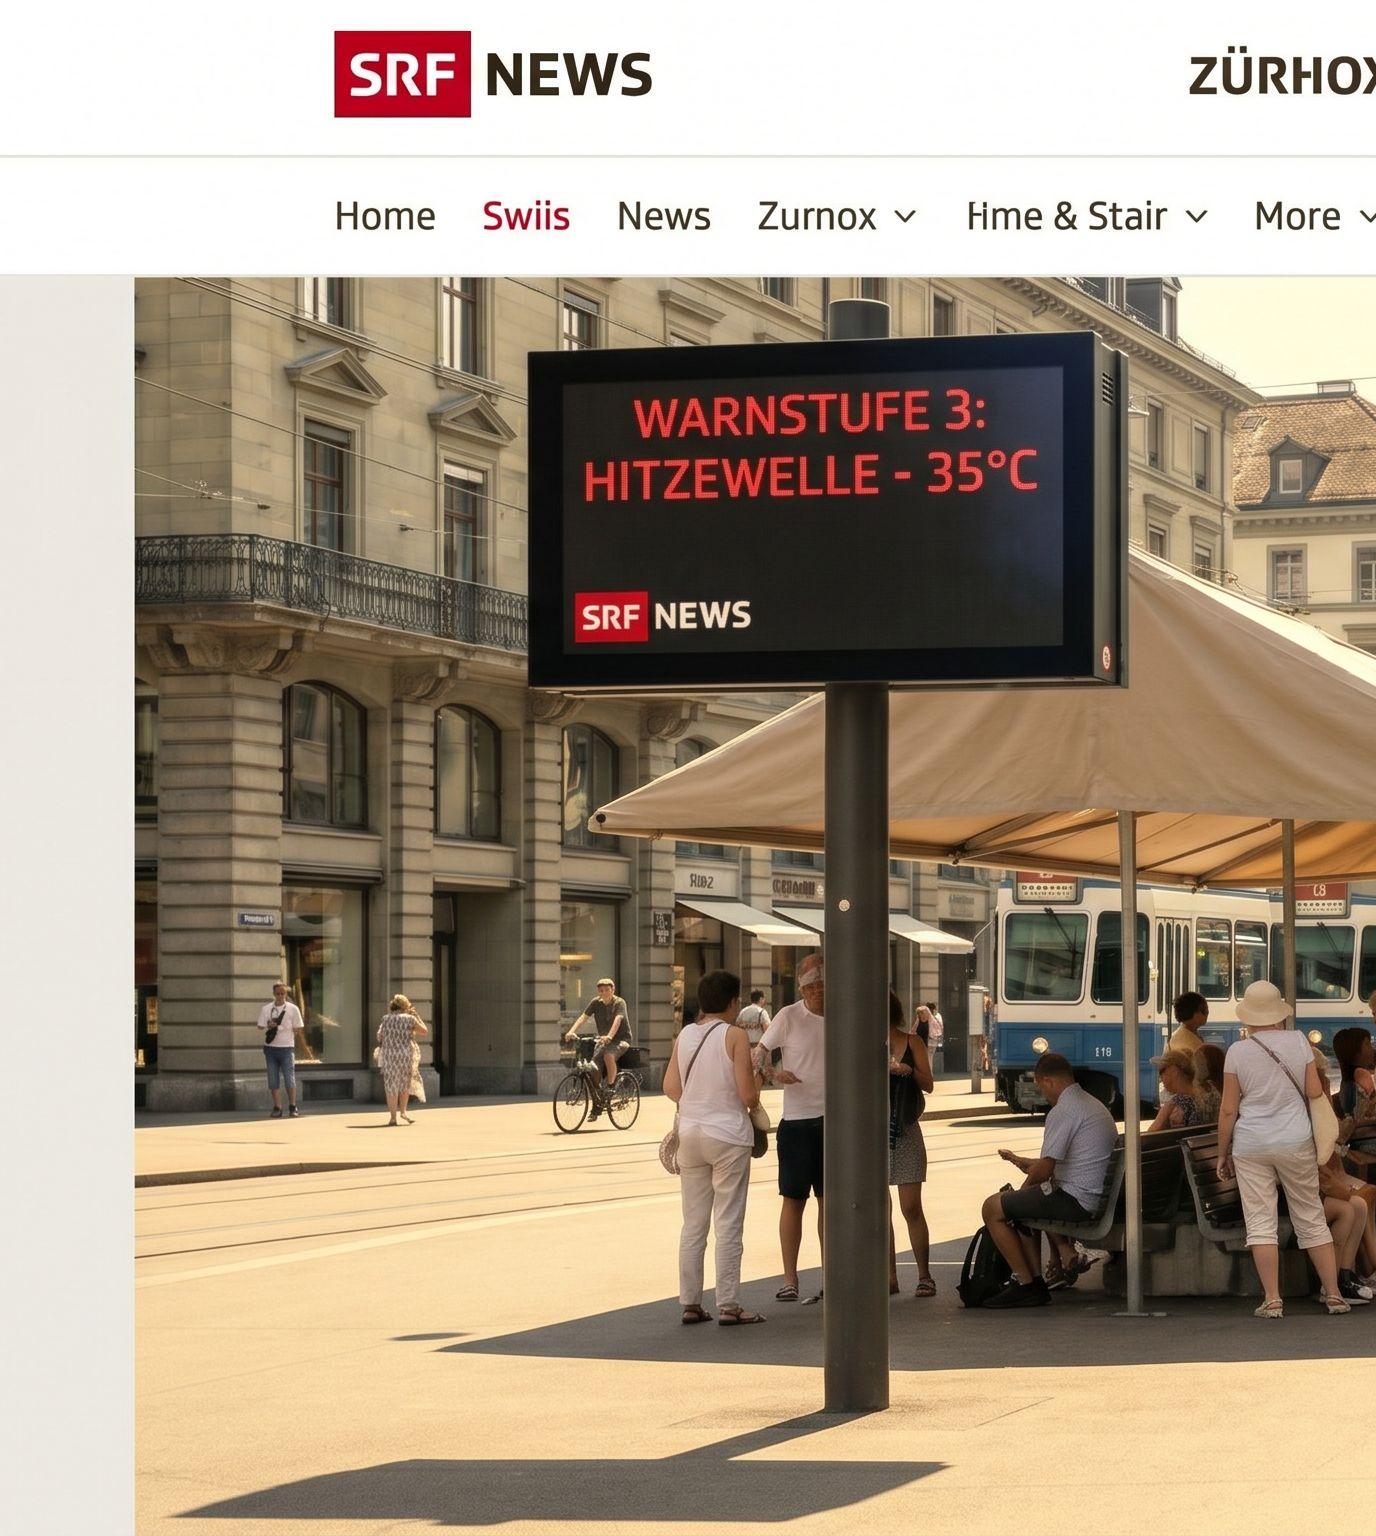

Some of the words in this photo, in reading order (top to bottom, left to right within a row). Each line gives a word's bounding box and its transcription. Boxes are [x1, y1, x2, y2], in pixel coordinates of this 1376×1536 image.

[634, 390, 929, 438] WARNSTUFE
[946, 389, 985, 429] 3:
[586, 454, 878, 501] HITZEWELLE
[929, 449, 1037, 493] 35°C
[582, 604, 640, 631] SRF
[655, 600, 751, 630] NEWS
